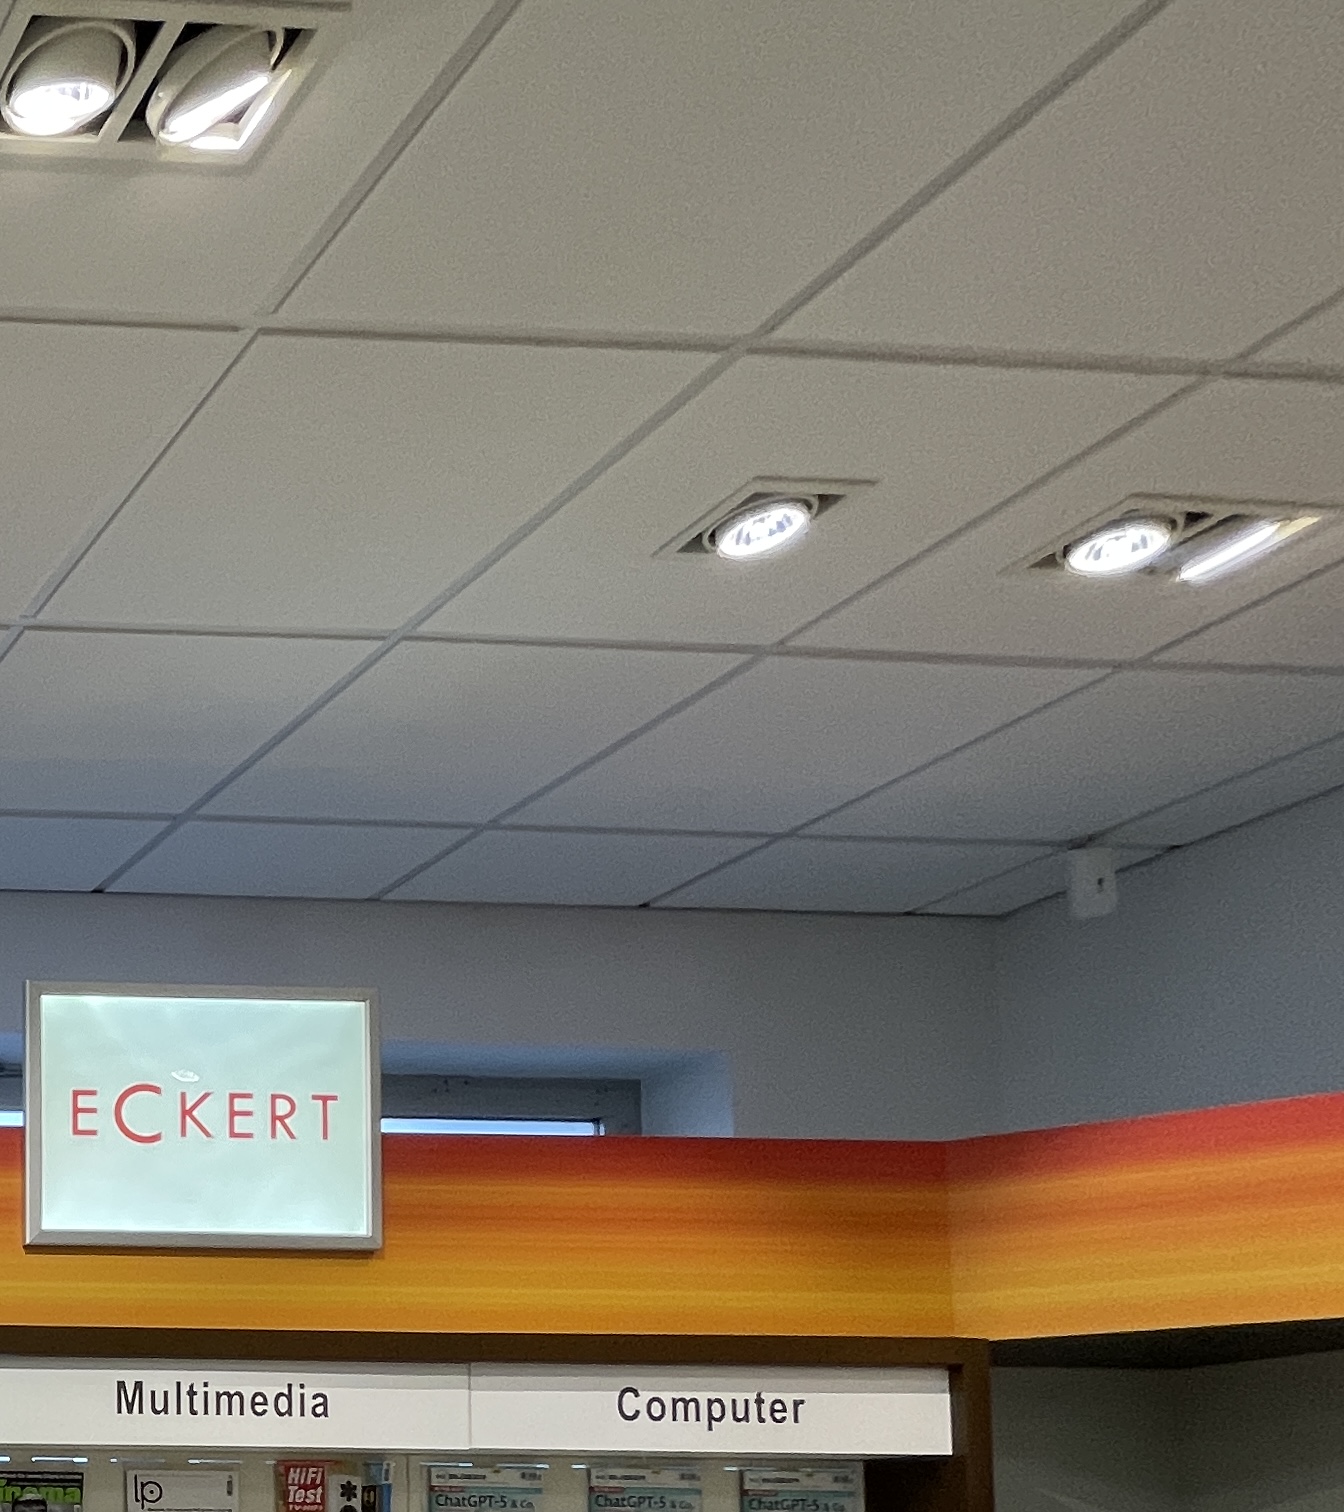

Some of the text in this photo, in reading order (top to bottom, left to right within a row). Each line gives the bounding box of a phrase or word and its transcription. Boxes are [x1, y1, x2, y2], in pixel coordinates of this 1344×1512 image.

[70, 1085, 339, 1143] ECKERT
[115, 1380, 330, 1419] Multimedia
[617, 1388, 806, 1430] Computer
